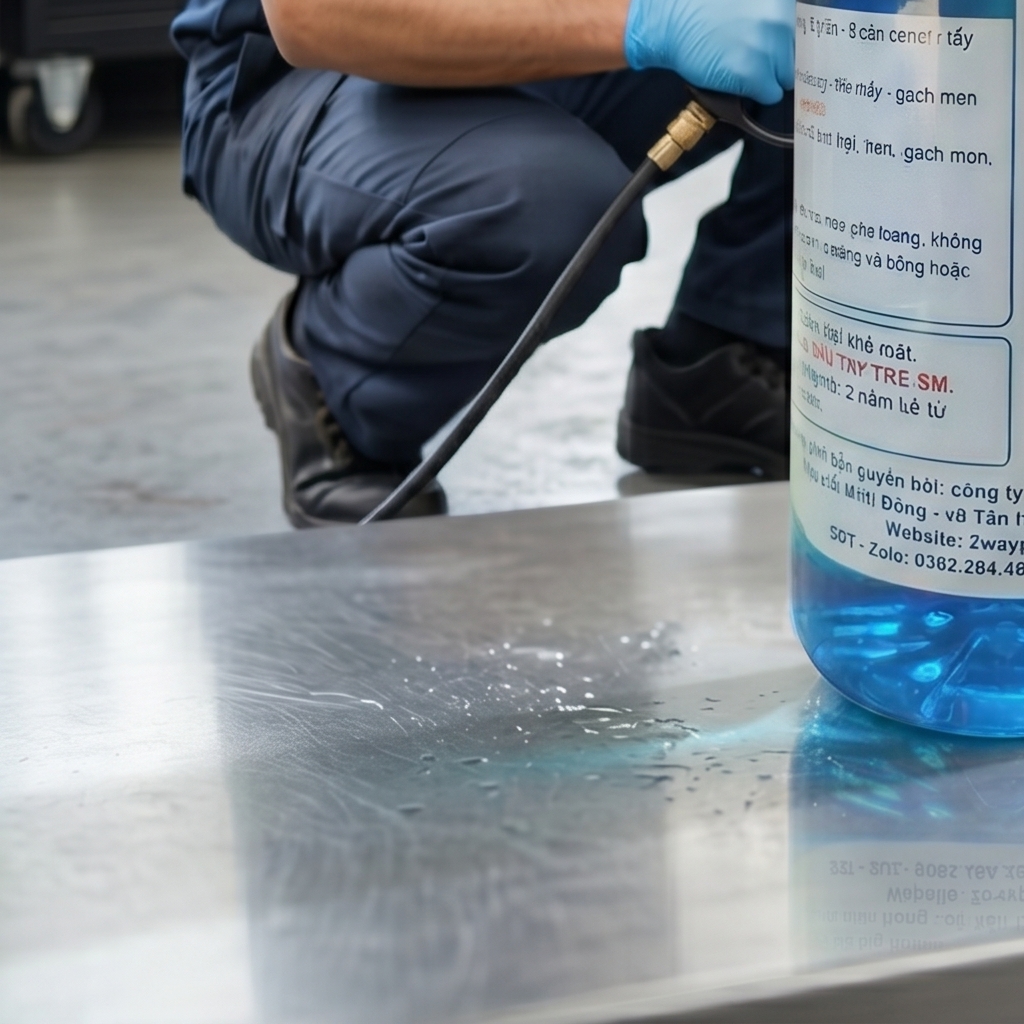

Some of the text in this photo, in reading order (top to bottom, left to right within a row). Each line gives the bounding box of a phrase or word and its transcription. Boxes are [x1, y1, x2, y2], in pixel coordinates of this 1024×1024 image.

[895, 87, 935, 105] gach
[940, 91, 977, 106] men
[931, 231, 982, 254] không
[886, 254, 925, 278] bông
[870, 364, 909, 388] TRE
[845, 385, 854, 401] 2
[951, 483, 999, 504] công
[1006, 485, 1024, 504] ty
[973, 509, 1009, 526] Tân
[886, 519, 963, 548] Website:
